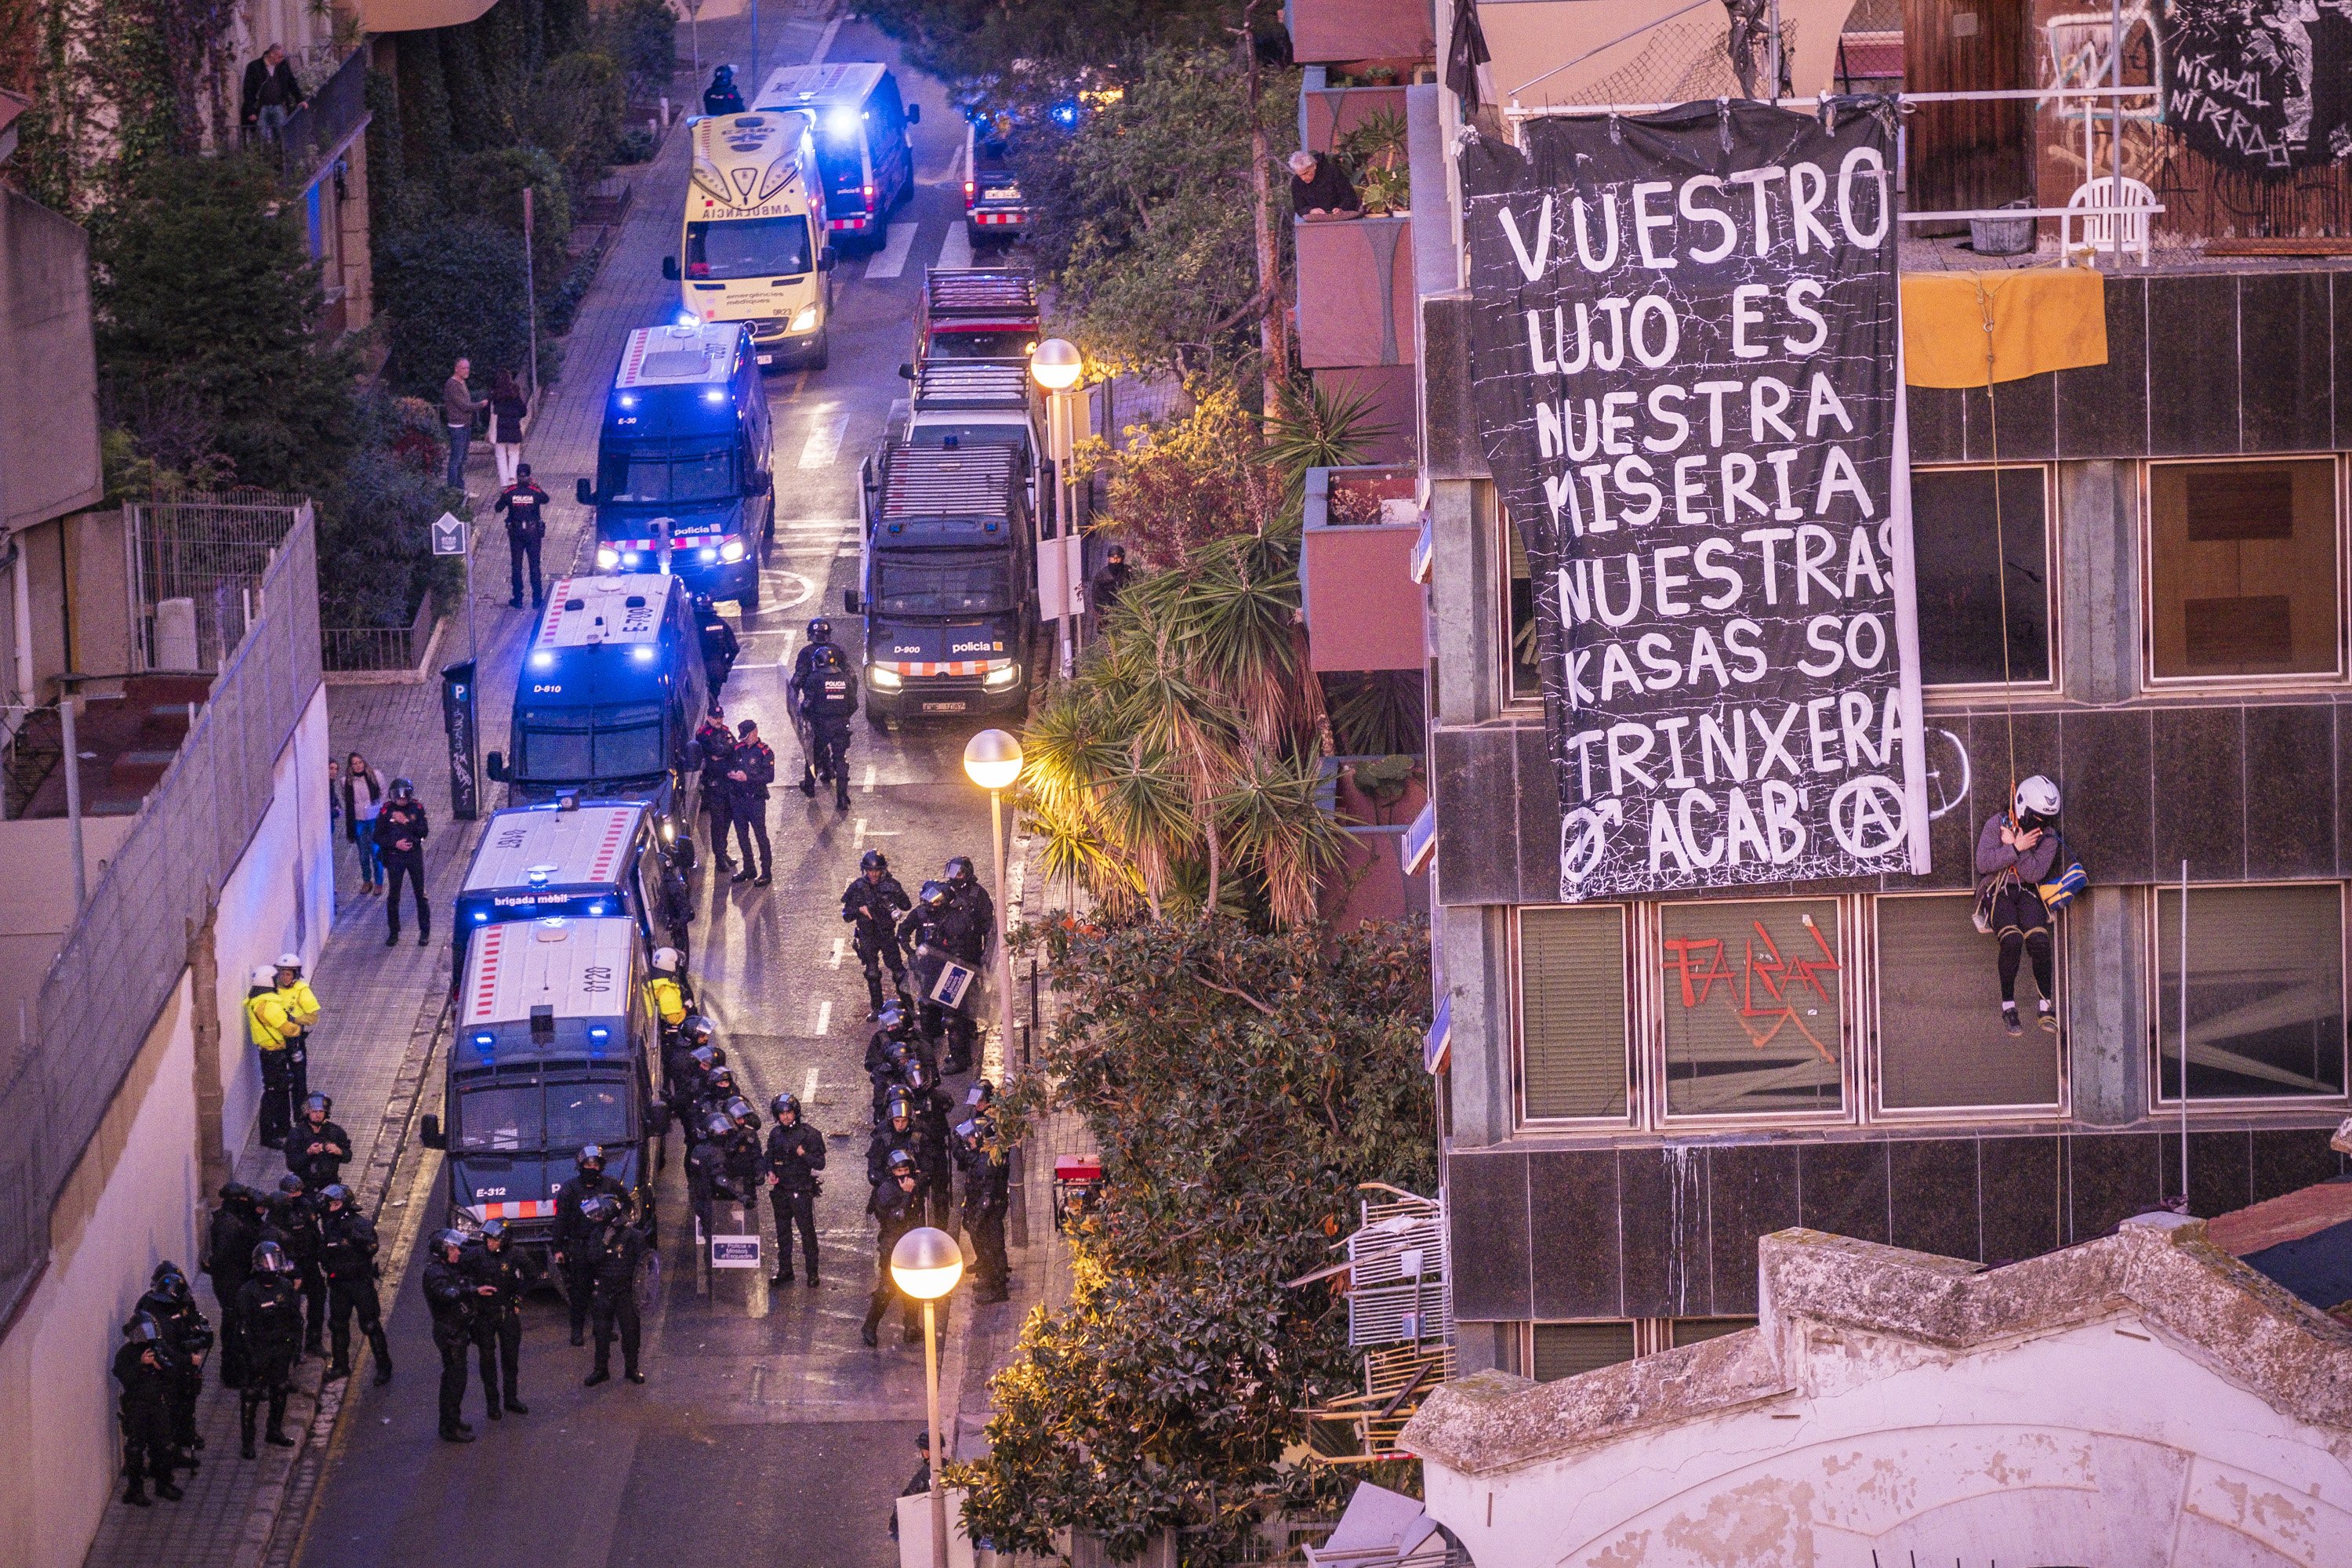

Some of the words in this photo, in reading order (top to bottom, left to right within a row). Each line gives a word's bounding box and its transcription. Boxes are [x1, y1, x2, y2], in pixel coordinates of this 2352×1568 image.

[1498, 147, 1889, 281] VUESTRO
[1527, 295, 1679, 374] LUJO
[1733, 279, 1828, 358] ES
[1537, 372, 1853, 461] NUESTRA
[674, 525, 710, 536] policia
[1543, 446, 1874, 536] MISERIA
[953, 641, 991, 653] policia
[1565, 619, 1768, 710] KASAS
[1566, 688, 1904, 800] TRINXERA
[1651, 779, 1808, 874] ACAB
[495, 896, 535, 906] brigada
[583, 967, 611, 992] 0120
[477, 1187, 506, 1197] E-312
